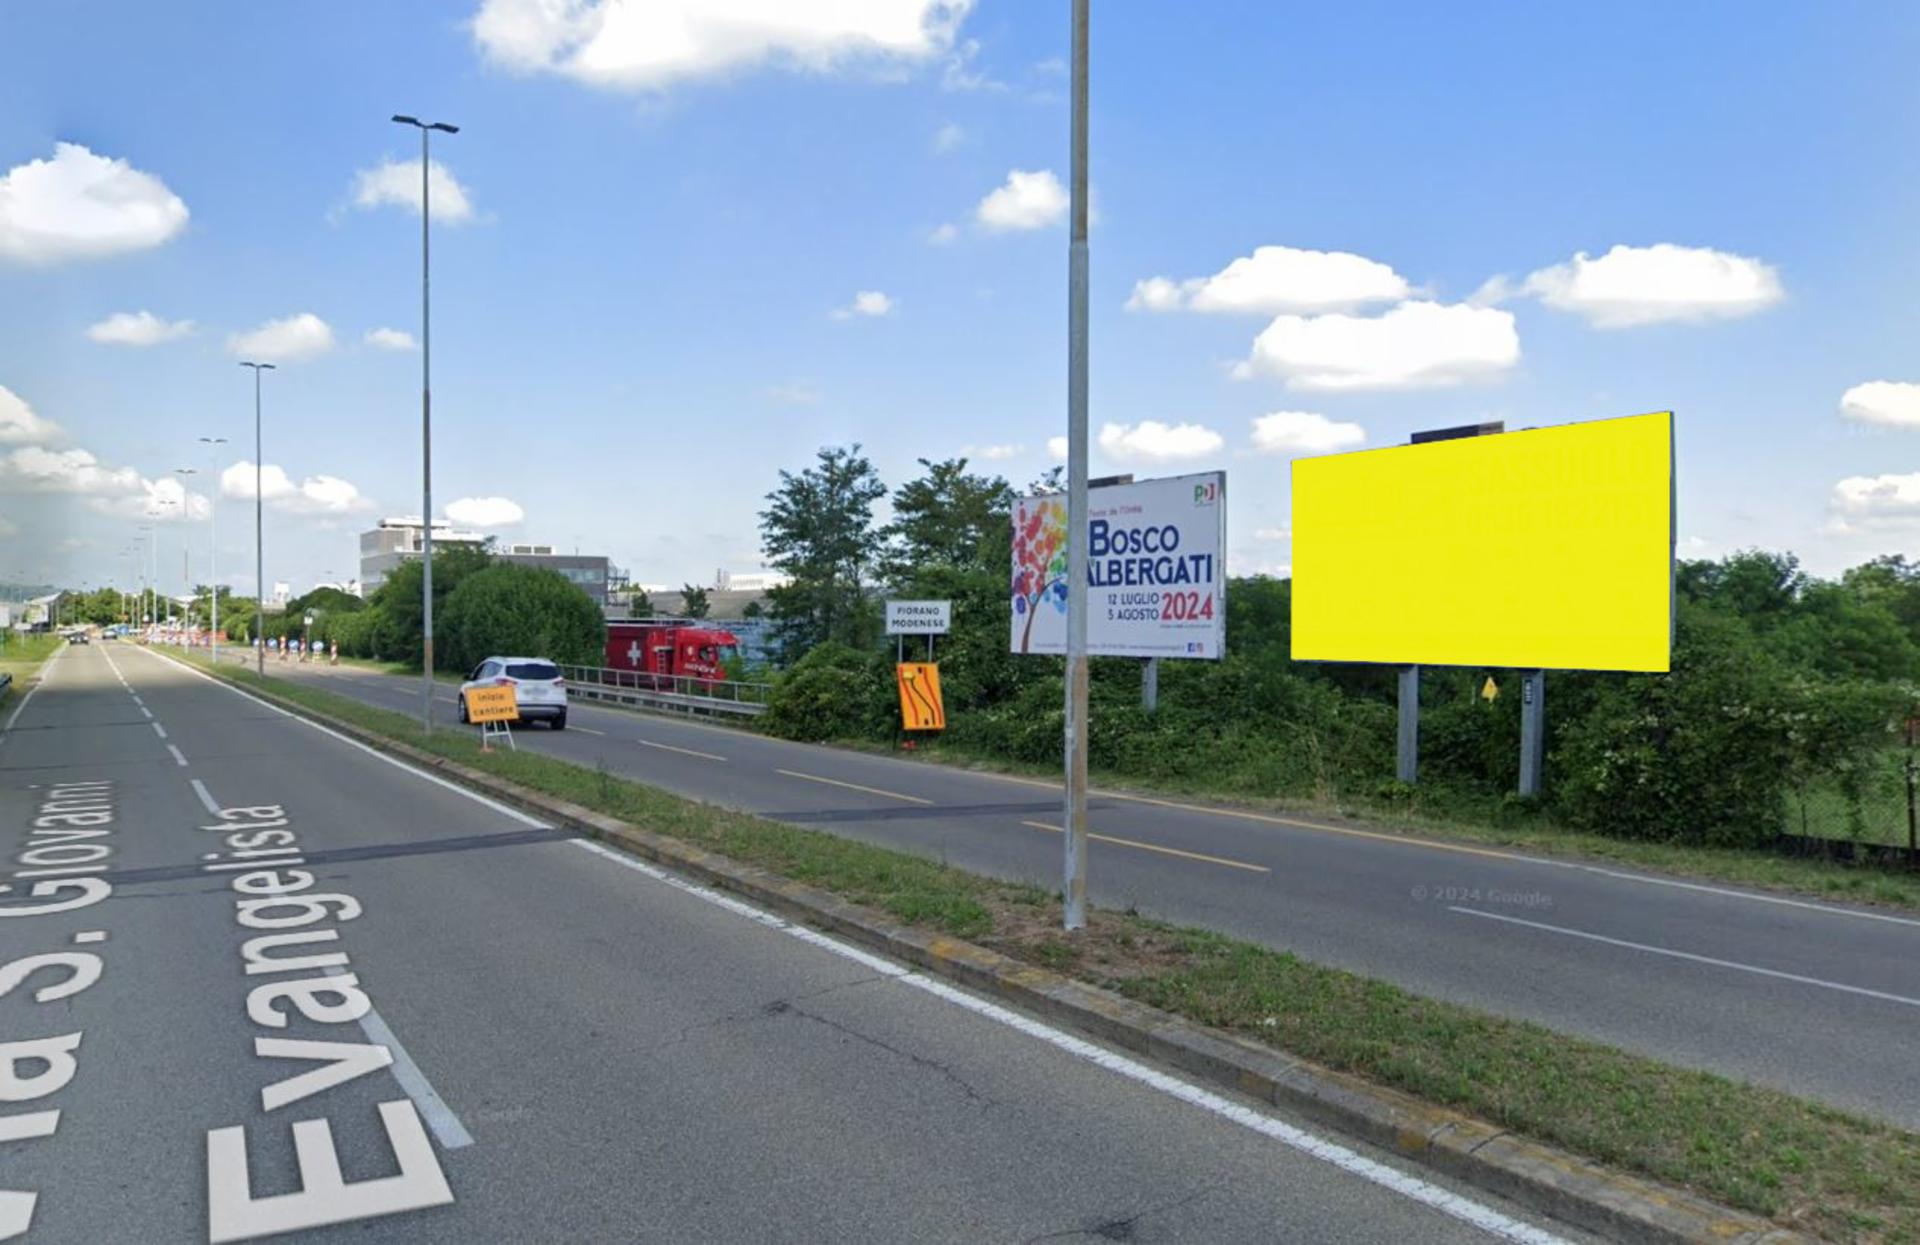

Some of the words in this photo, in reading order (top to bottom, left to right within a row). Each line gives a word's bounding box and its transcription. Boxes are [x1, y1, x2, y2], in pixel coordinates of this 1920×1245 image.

[1121, 592, 1160, 606] LUGLIO
[1161, 591, 1214, 621] 2024
[897, 607, 940, 615] FIORANO
[1117, 607, 1160, 621] AGOSTO
[892, 620, 945, 628] MODENESE
[200, 803, 455, 1245] Evangelista
